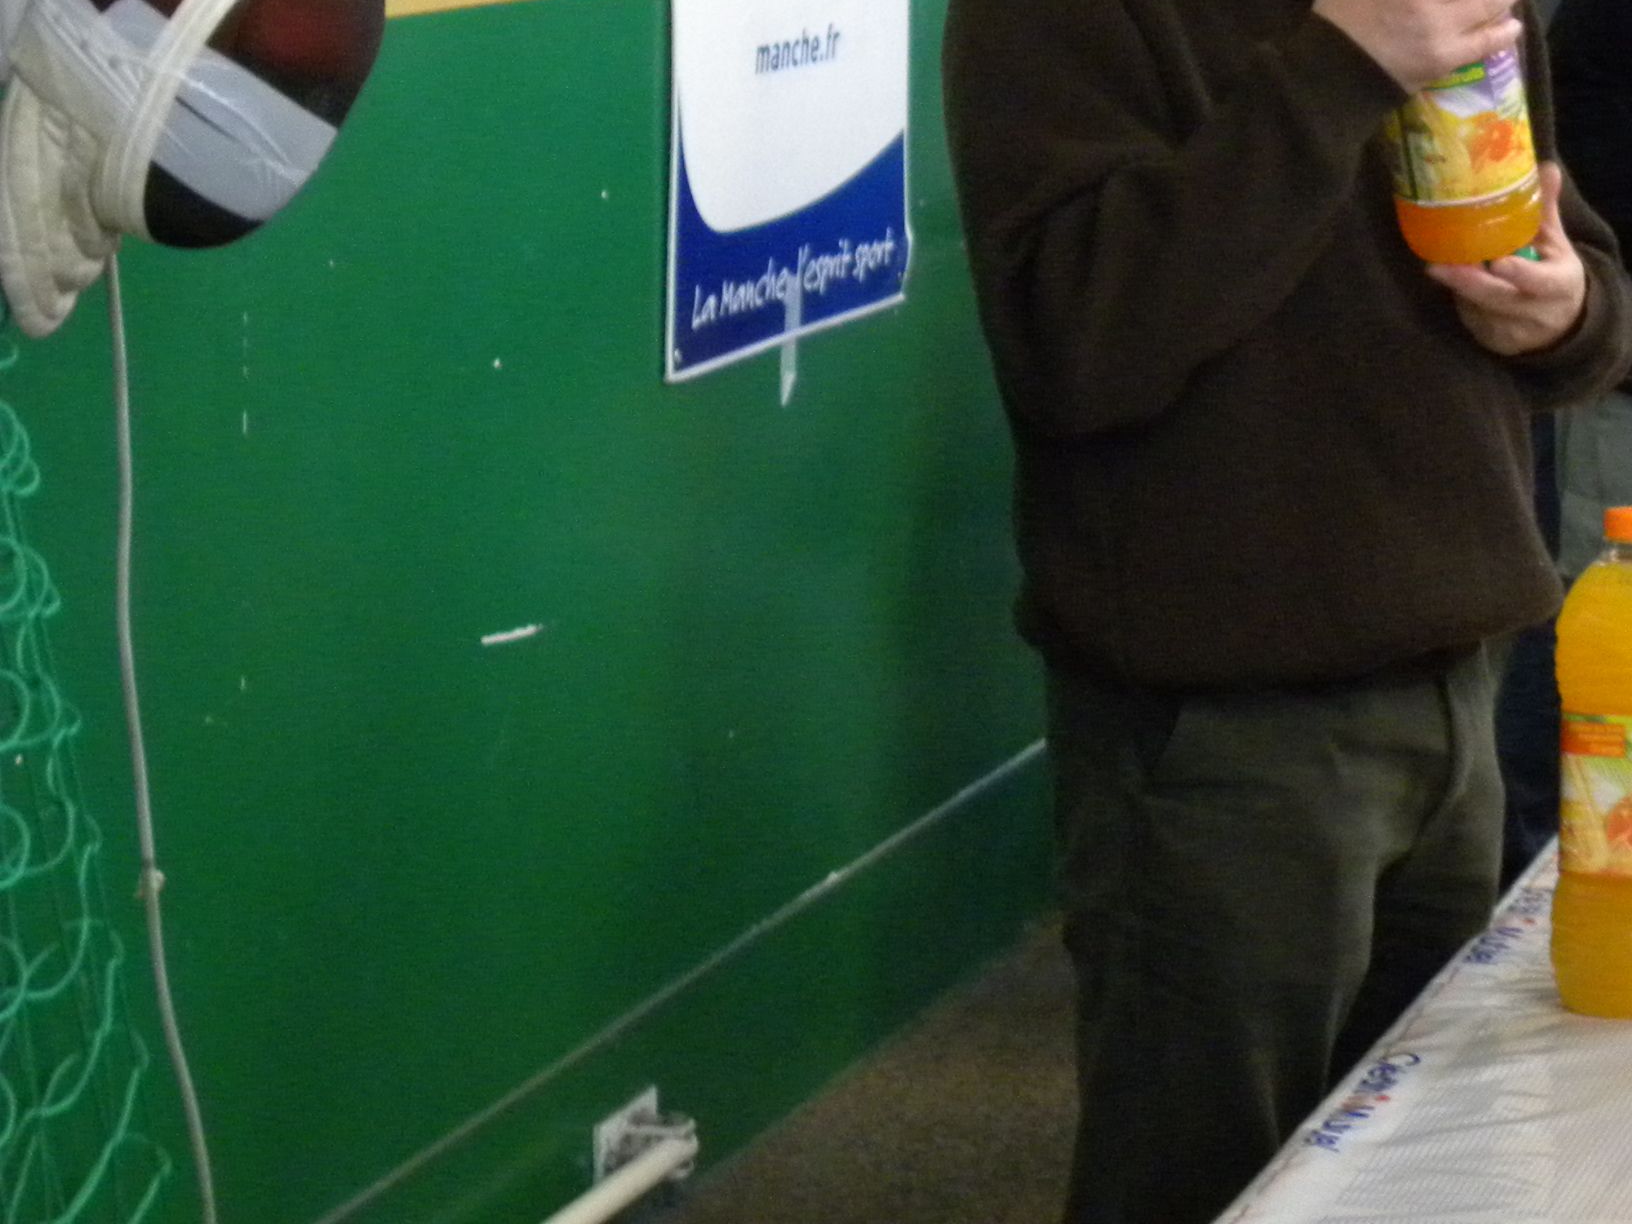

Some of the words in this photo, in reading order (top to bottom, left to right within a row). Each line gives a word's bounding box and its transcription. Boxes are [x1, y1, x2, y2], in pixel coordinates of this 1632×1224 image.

[755, 22, 840, 75] manche.fr
[691, 283, 719, 330] La
[720, 255, 789, 318] Manche
[796, 237, 851, 296] l'esprit
[852, 225, 895, 284] sport
